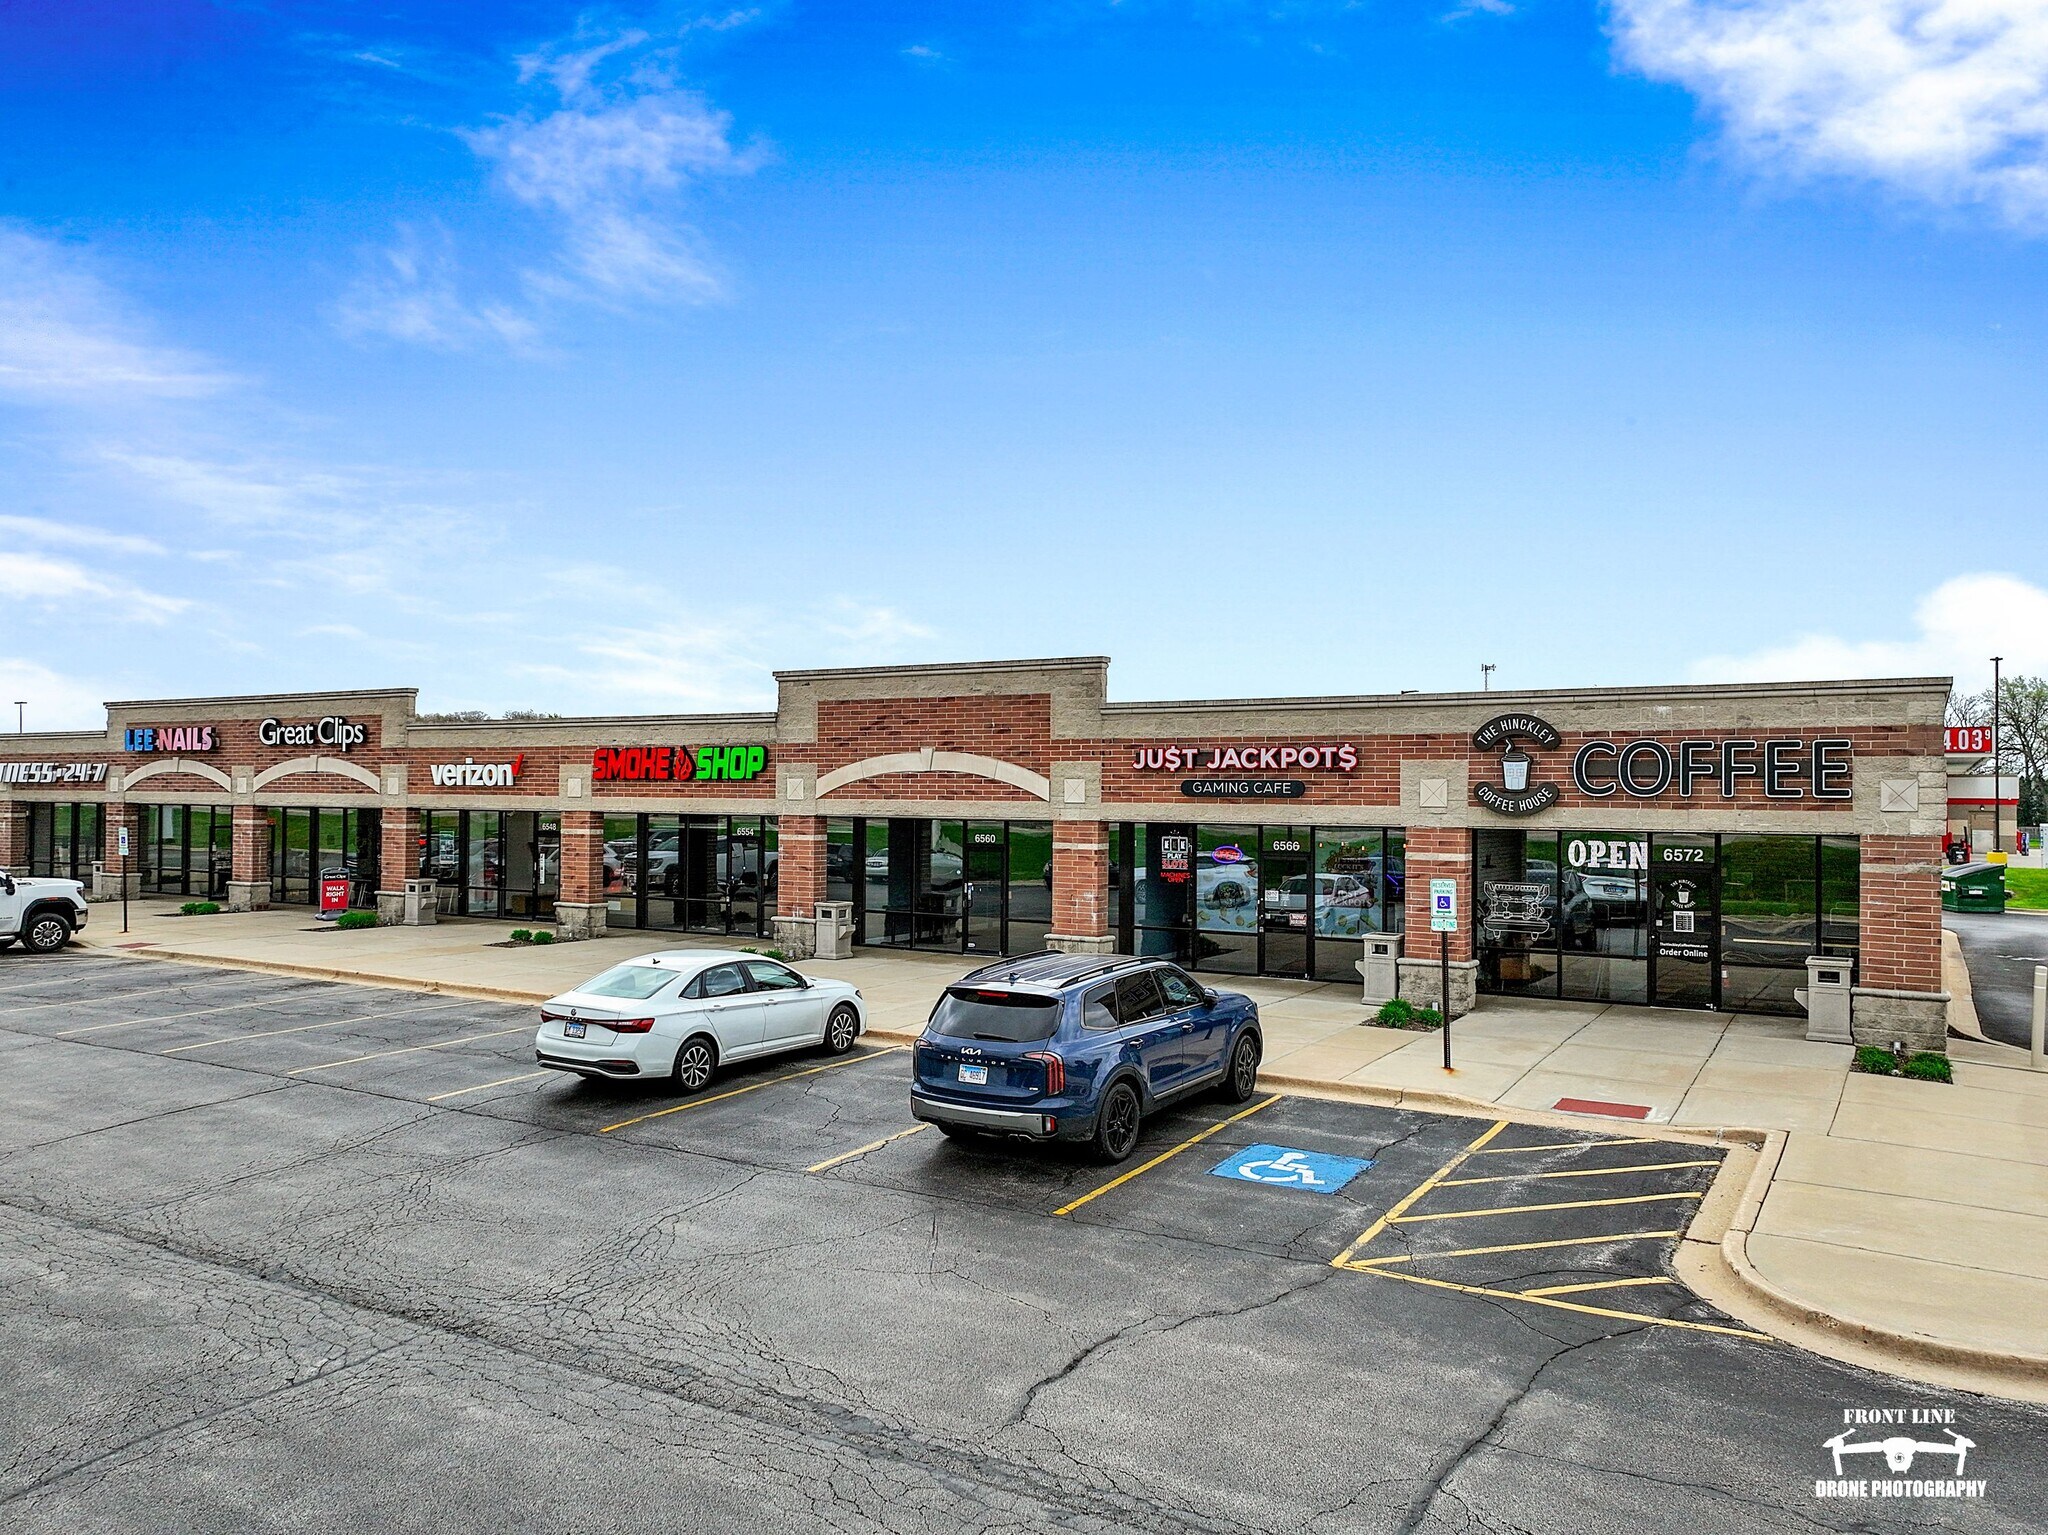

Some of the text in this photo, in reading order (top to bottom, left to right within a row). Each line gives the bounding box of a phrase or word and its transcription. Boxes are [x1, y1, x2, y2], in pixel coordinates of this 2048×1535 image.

[125, 726, 213, 751] LEE NAILS
[259, 717, 364, 751] Great Clips
[1477, 718, 1555, 745] THE HINCKLEY
[592, 746, 765, 780] SMOKE SHOP
[1573, 740, 1852, 798] COFFEE
[430, 757, 514, 786] verizon
[1192, 782, 1291, 794] GAMING CAFE
[1478, 786, 1553, 812] COFFEE HOUSE
[736, 827, 754, 836] 6554
[974, 834, 996, 843] 6560
[1273, 841, 1300, 851] 6566
[1567, 840, 1648, 870] OPEN
[1663, 848, 1704, 862] 6572
[1161, 859, 1188, 869] SLOTS
[1670, 900, 1696, 909] COFFEE HOUSE
[1683, 949, 1708, 957] Online
[961, 1047, 982, 1055] KIA
